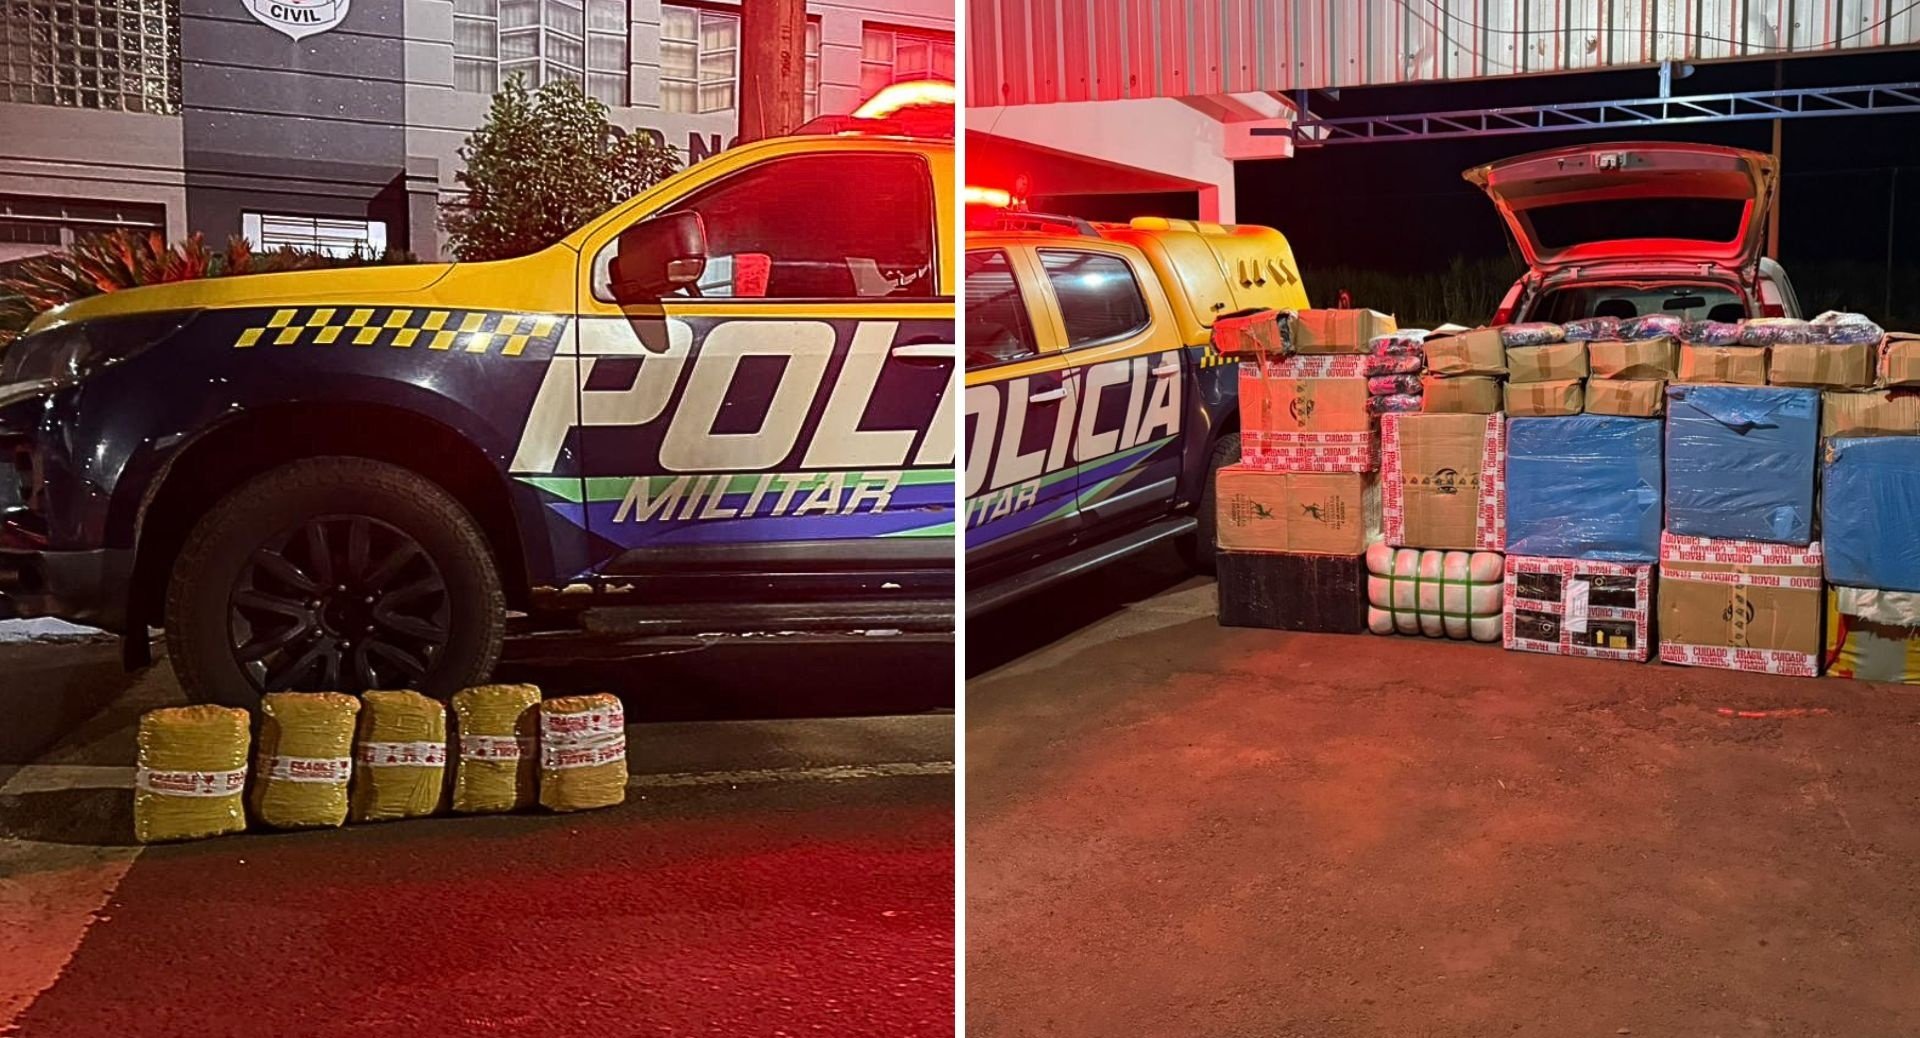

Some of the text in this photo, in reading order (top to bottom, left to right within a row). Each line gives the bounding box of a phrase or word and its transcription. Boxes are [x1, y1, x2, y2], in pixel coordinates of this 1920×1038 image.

[270, 4, 321, 22] CIVIL
[1324, 433, 1353, 442] CUIDADO
[1323, 447, 1351, 456] CUIDADO
[612, 471, 903, 524] MILITAR
[1679, 551, 1706, 561] FRAGIL
[1715, 553, 1753, 564] CUIDADO
[1763, 554, 1792, 565] FRAGIL
[1701, 573, 1741, 584] CUIDADO
[1750, 575, 1780, 587] FRAGIL
[1589, 607, 1613, 619] CUIDA
[1693, 646, 1728, 658] CUIDADO
[1736, 649, 1764, 661] FRAGIL
[1771, 651, 1807, 663] CUIDADO
[290, 760, 337, 772] FRAGILE
